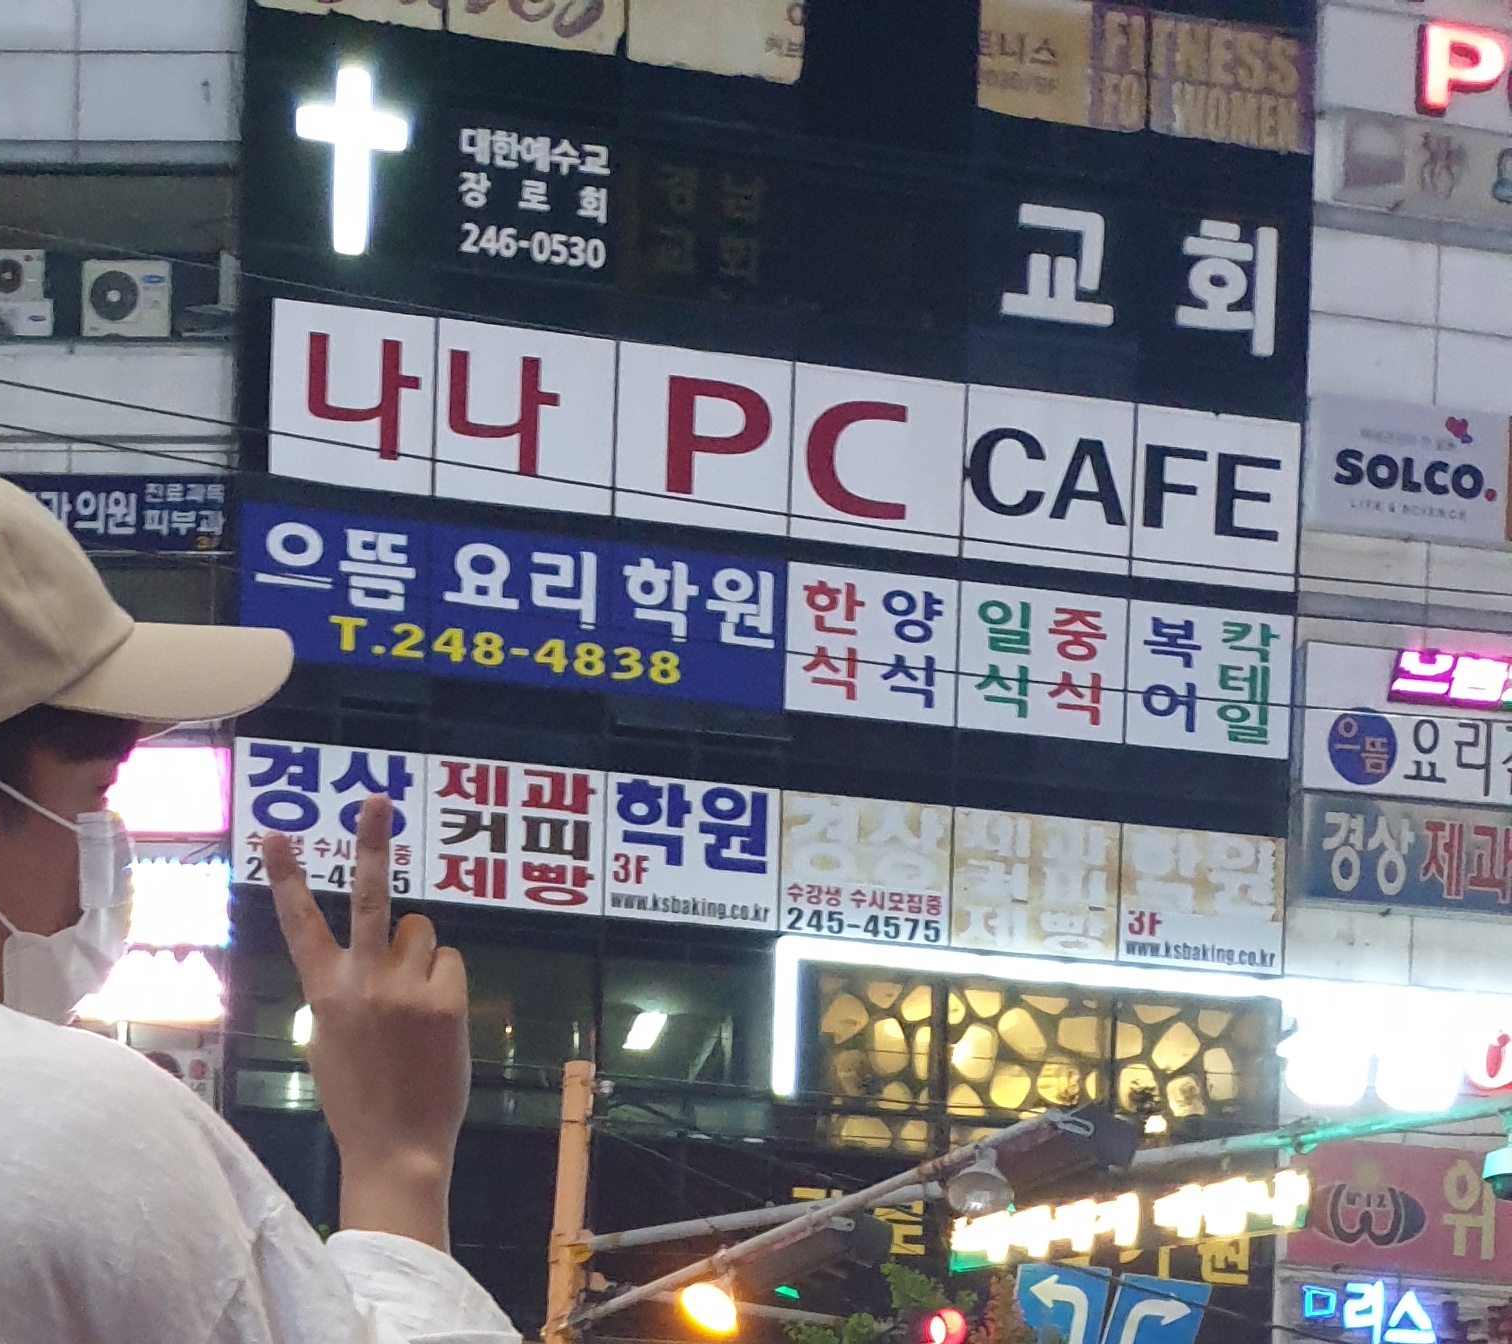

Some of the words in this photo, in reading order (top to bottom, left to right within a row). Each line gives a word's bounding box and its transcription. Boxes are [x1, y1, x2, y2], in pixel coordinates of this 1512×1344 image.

[459, 128, 611, 176] 대한예수교
[459, 222, 606, 269] 246-0530
[307, 331, 560, 476] 나나
[666, 375, 907, 520] PC
[968, 428, 1281, 542] CAFE
[142, 509, 226, 536] 피부과
[254, 522, 416, 612] 으뜸
[443, 543, 597, 629] 요리
[622, 558, 775, 649] 학원
[329, 615, 682, 685] T.248-4838
[1403, 719, 1512, 797] 요리
[248, 743, 414, 840] 경상
[615, 778, 769, 874] 학원
[436, 761, 597, 815] 제과
[440, 807, 592, 862] 커피
[1323, 811, 1415, 896] 경상
[434, 853, 594, 907] 제빵
[613, 853, 650, 884] 3F
[610, 891, 771, 923] www.ksbaking.co.kr
[788, 883, 844, 908] 수강생
[850, 887, 943, 917] 수시모집중
[788, 906, 942, 944] 245-4575
